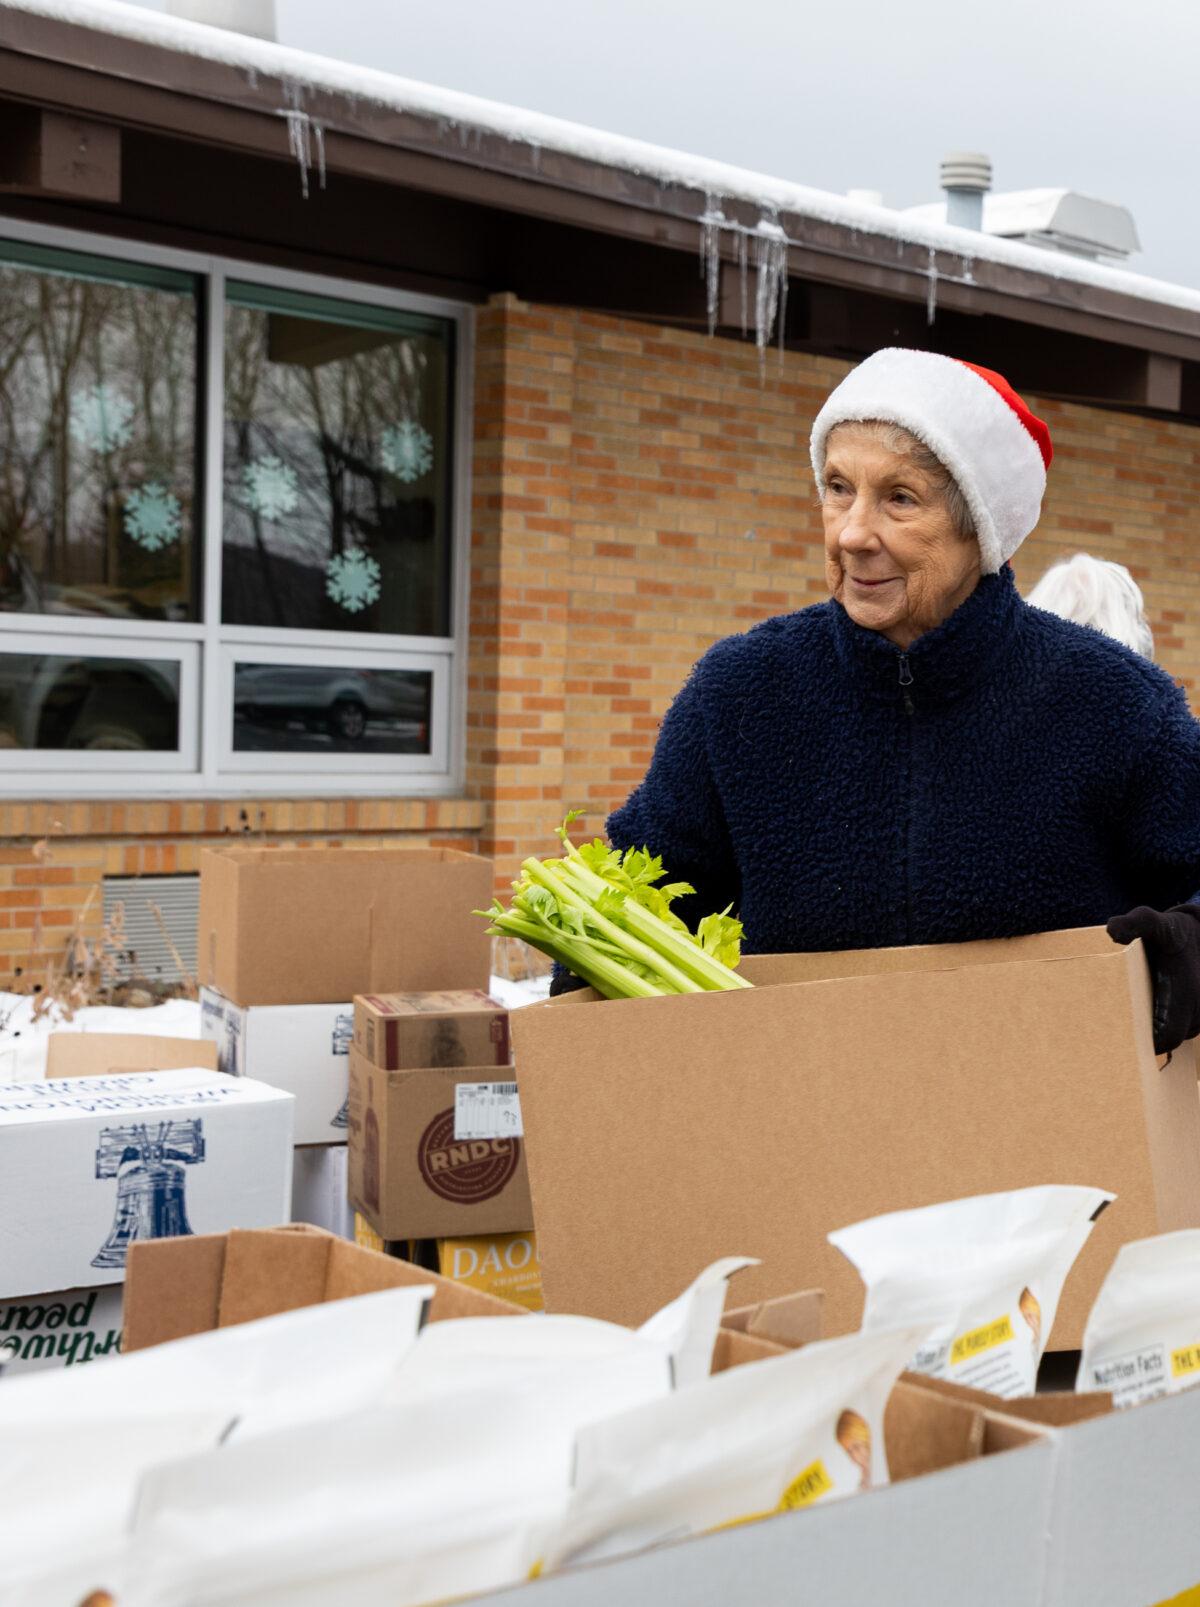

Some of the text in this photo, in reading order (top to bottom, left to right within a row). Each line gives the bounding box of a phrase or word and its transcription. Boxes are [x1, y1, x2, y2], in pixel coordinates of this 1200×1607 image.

[430, 1139, 509, 1171] RNDC
[0, 1292, 98, 1331] pear
[0, 1330, 122, 1366] rthwe
[1175, 1354, 1194, 1372] THE
